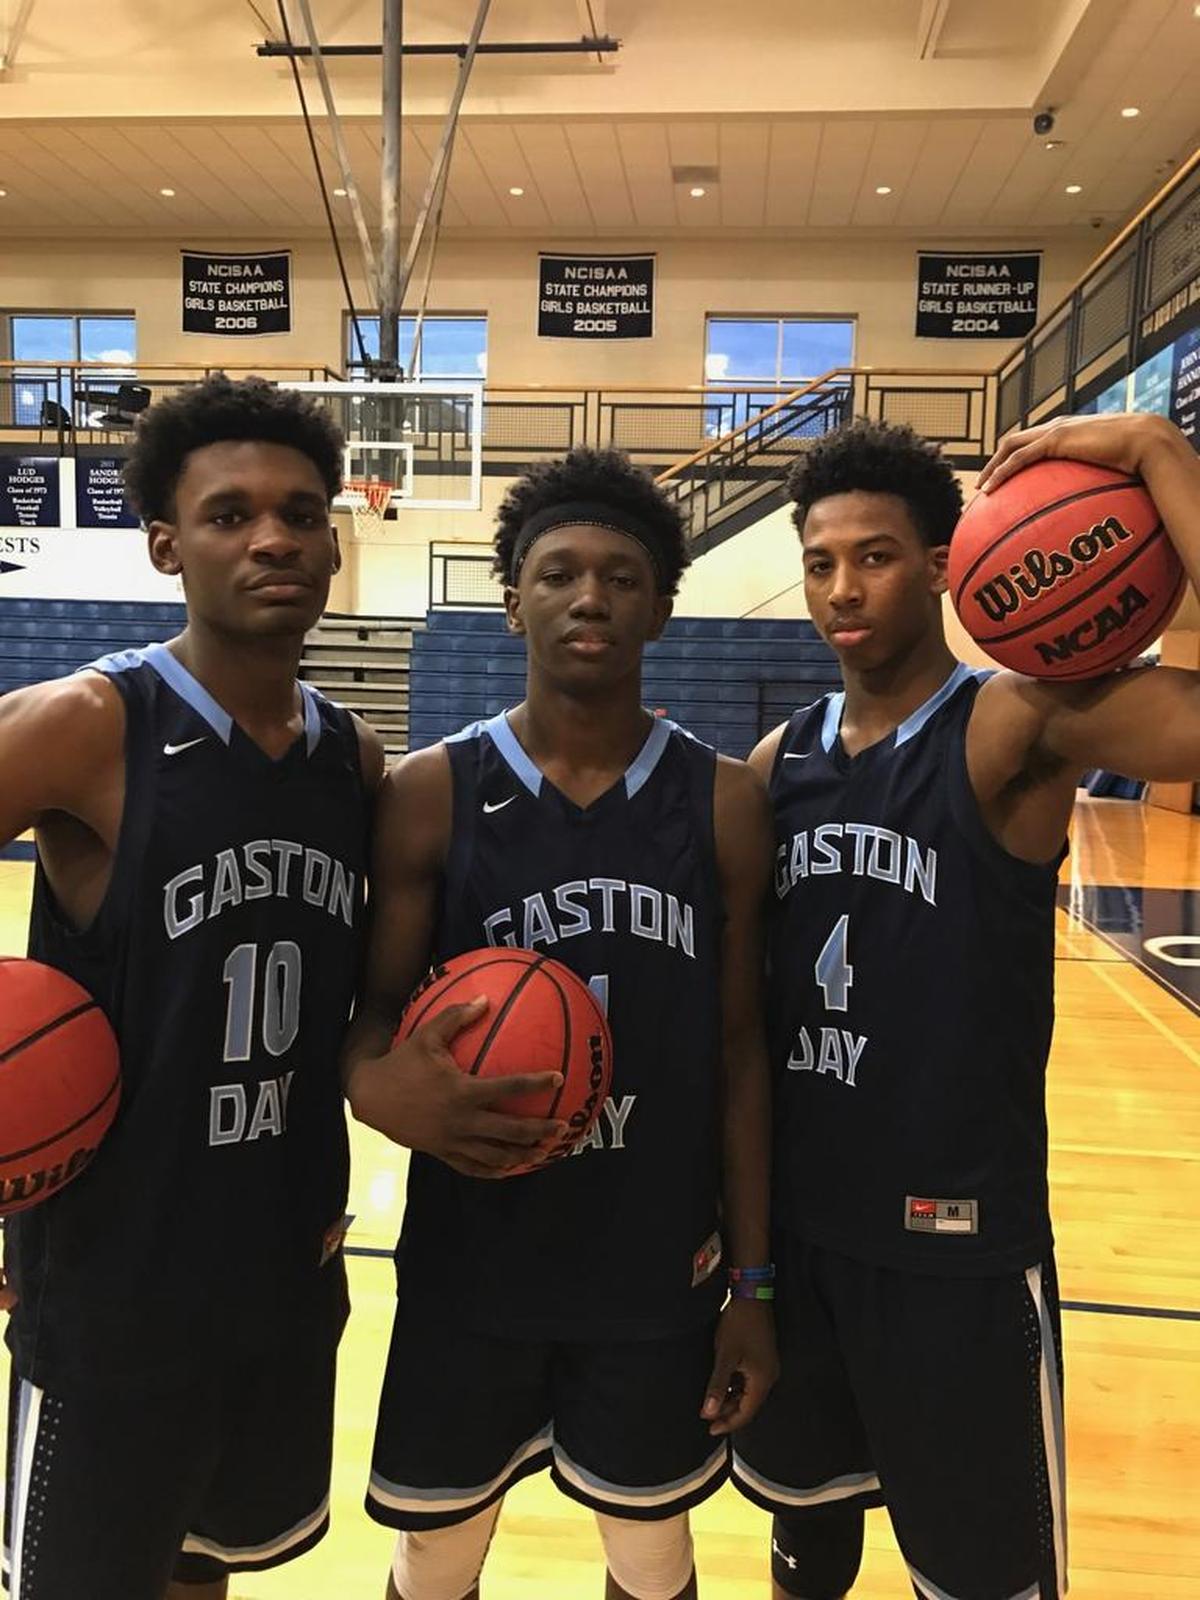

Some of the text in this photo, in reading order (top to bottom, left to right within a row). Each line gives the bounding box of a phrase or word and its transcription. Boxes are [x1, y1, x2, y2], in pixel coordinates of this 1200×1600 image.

[207, 264, 263, 277] NCISAA
[564, 267, 628, 279] NCISAA
[946, 264, 1011, 278] NCISAA
[189, 280, 284, 294] STATE CHAMPIONS
[545, 283, 648, 297] STATE CHAMPIONS
[922, 282, 1035, 296] STATE RUNNER-UP
[185, 296, 288, 312] GIRLS BASKETBALL
[541, 300, 650, 315] GIRLS BASKETBALL
[918, 300, 1036, 315] GIRLS BASKETBALL
[215, 317, 257, 329] 2006
[573, 319, 617, 332] 2005
[951, 319, 1000, 332] 2004
[17, 468, 37, 476] LUD
[8, 476, 45, 484] HODGES
[973, 515, 1134, 624] Wilson
[1034, 583, 1150, 665] NCAA
[775, 823, 938, 907] GASTON
[163, 838, 356, 940] GASTON
[482, 877, 697, 960] GASTON
[814, 913, 854, 1012] 4
[222, 940, 301, 1064] 10
[947, 1205, 960, 1218] M
